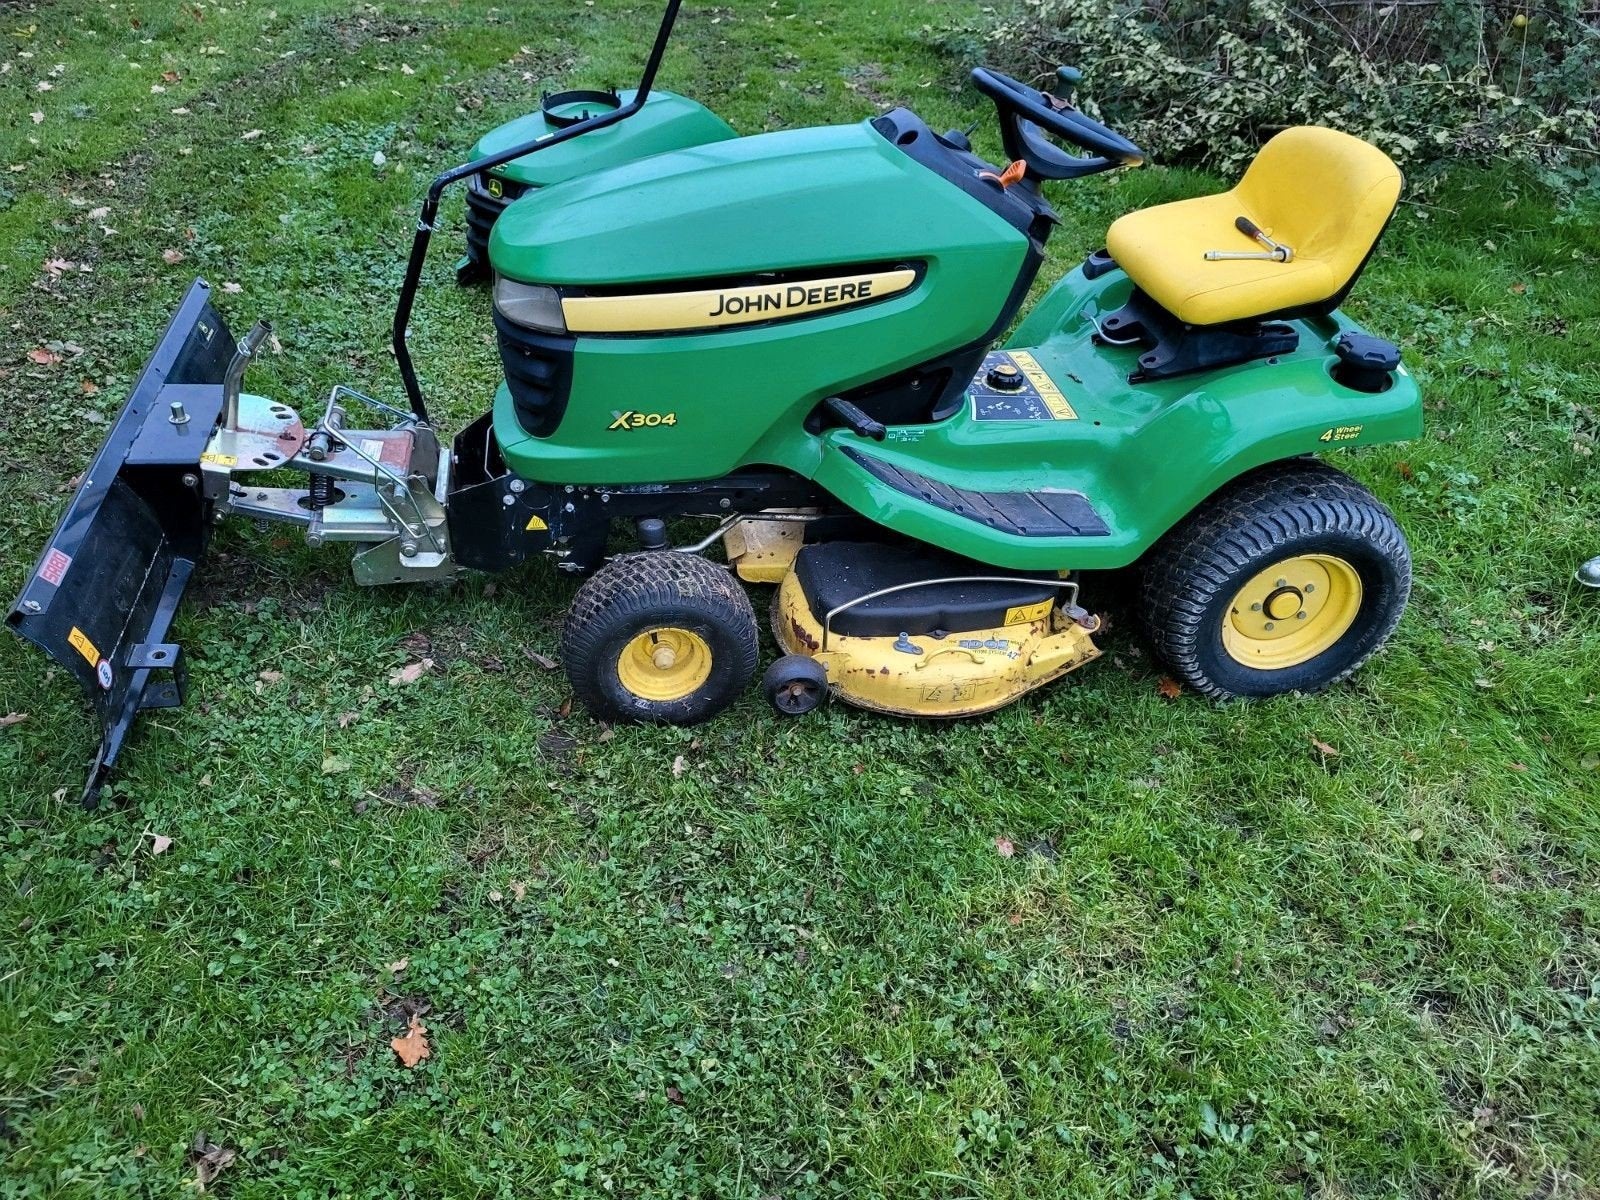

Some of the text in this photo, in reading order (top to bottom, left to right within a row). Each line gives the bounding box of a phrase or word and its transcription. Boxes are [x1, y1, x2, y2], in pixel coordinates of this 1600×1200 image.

[709, 280, 873, 317] JOHN DEERE
[608, 410, 677, 430] X304
[1320, 424, 1363, 441] 4 Wheel
